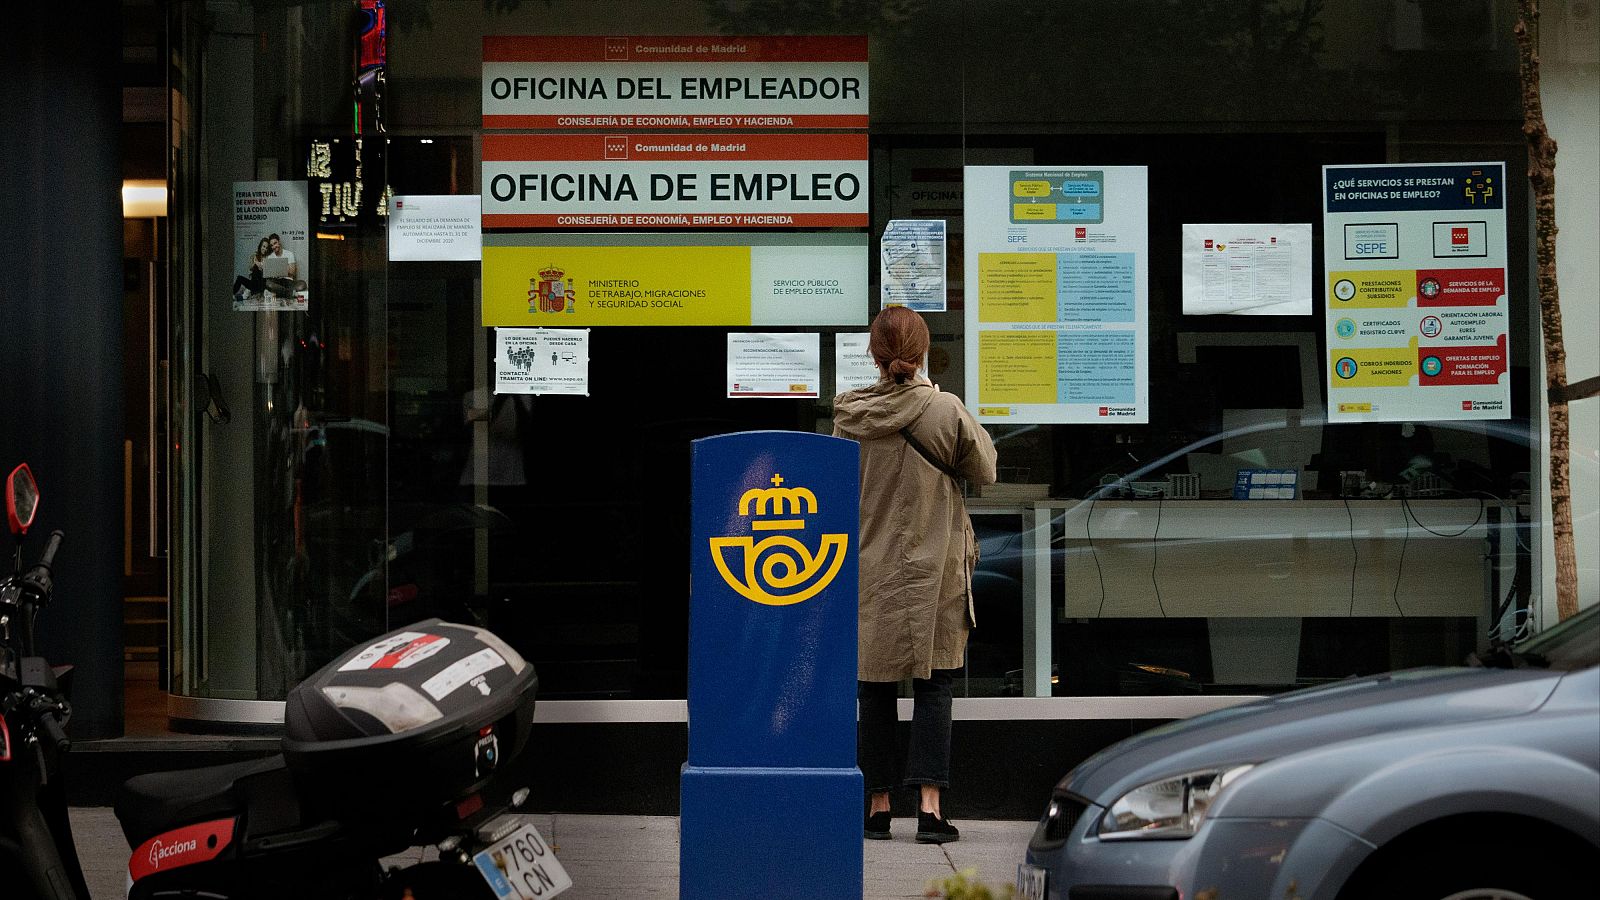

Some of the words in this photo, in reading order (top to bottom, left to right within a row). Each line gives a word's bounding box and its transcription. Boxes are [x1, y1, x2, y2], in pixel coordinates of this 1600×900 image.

[635, 44, 693, 53] Comunidad
[696, 44, 708, 53] de
[711, 44, 746, 53] Madrid
[491, 78, 607, 100] OFICINA
[616, 78, 671, 100] DEL
[681, 78, 860, 100] EMPLEADOR
[558, 116, 618, 126] CONSEJERÍA
[620, 116, 633, 126] DE
[636, 116, 691, 127] ECONOMÍA,
[693, 118, 732, 126] EMPLEO
[735, 118, 741, 126] Y
[635, 144, 692, 152] Comunidad
[696, 144, 708, 152] de
[711, 144, 746, 152] Madrid
[491, 173, 638, 202] OFICINA
[651, 173, 697, 202] DE
[711, 173, 860, 202] EMPLEO
[1333, 179, 1355, 189] ¿QUÉ
[1357, 179, 1402, 187] SERVICIOS
[1416, 178, 1454, 186] PRESTAN
[912, 191, 957, 200] OFICINA
[1335, 192, 1346, 200] EN
[1348, 192, 1388, 200] OFICINAS
[558, 214, 618, 225] CONSEJERÍA
[620, 216, 633, 225] DE
[635, 214, 690, 226] ECONOMÍA,
[693, 216, 732, 225] EMPLEO
[735, 216, 741, 225] Y
[744, 216, 793, 225] HACIENDA
[1356, 243, 1387, 254] SEPE
[602, 290, 642, 299] TRABAJO,
[158, 840, 196, 858] acciona
